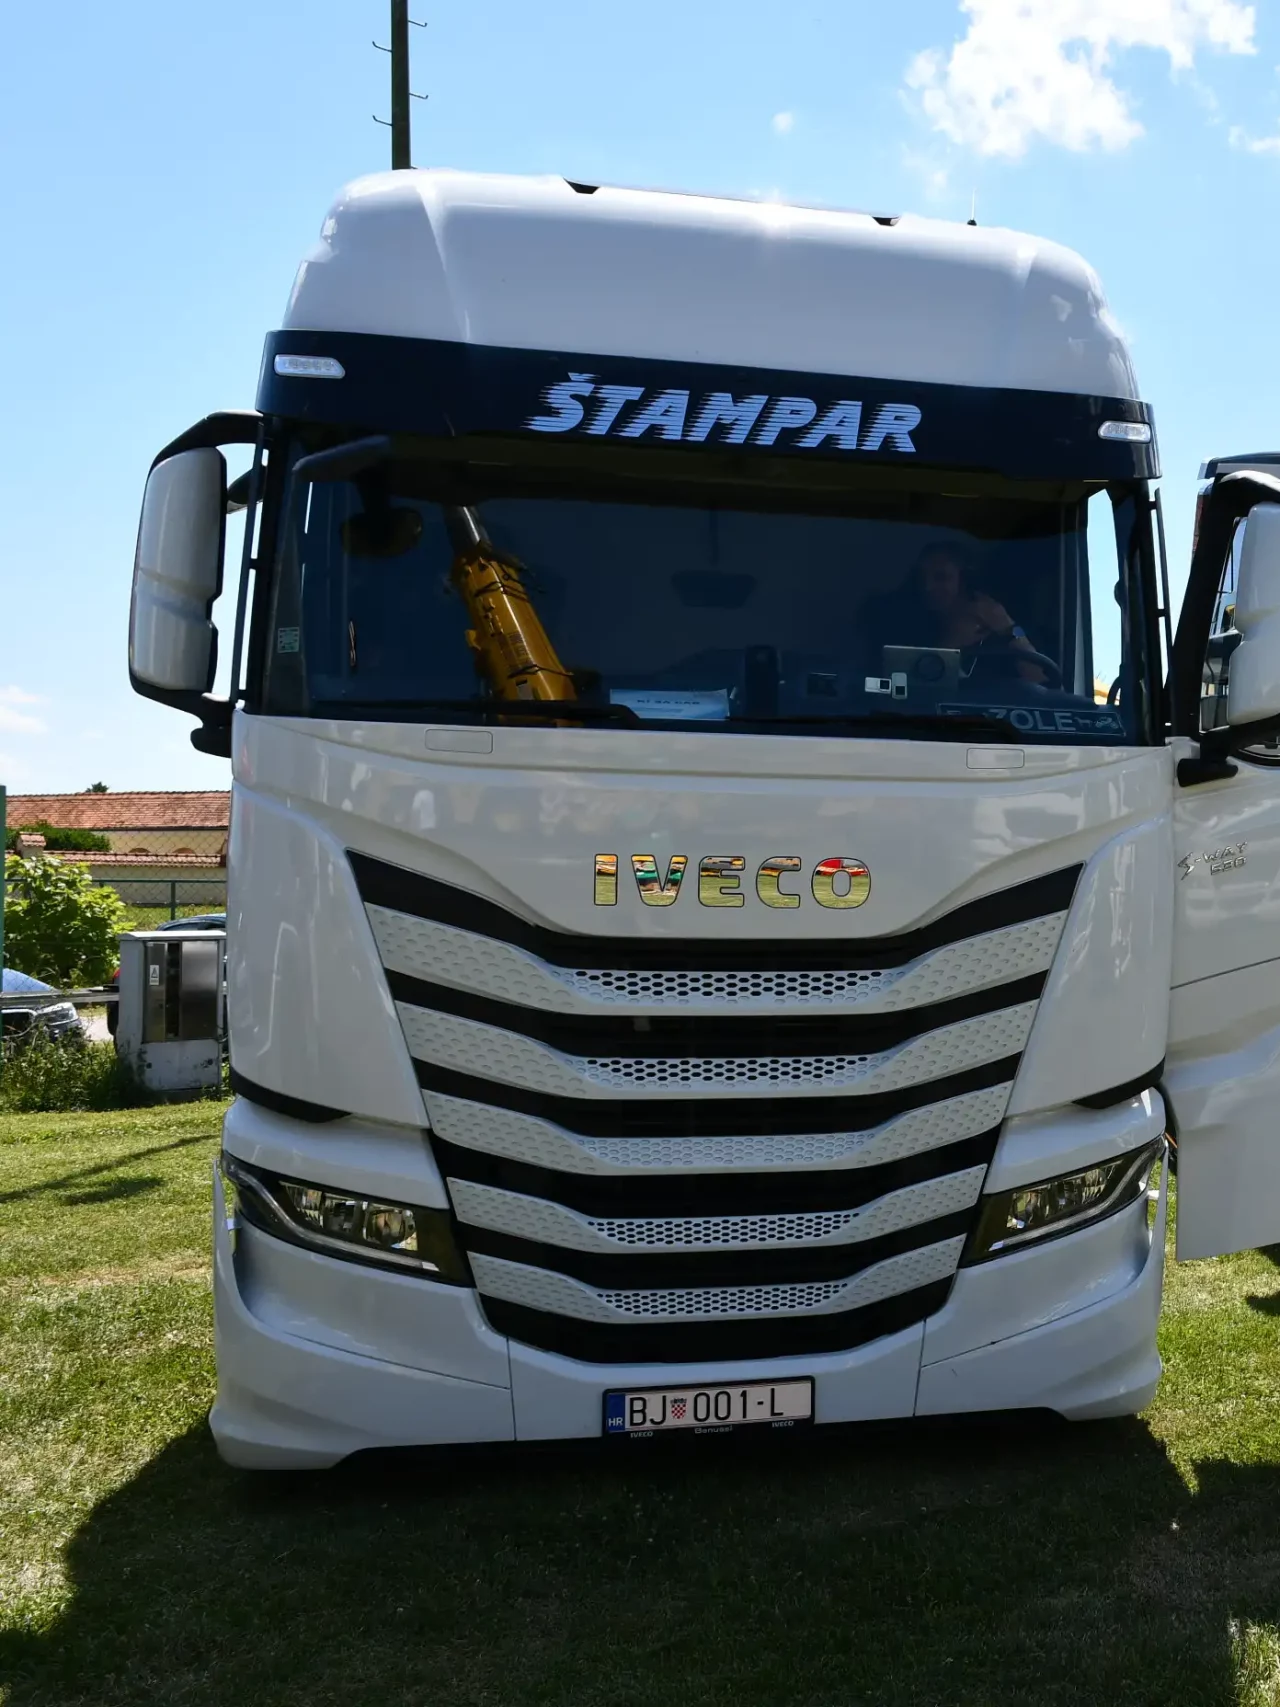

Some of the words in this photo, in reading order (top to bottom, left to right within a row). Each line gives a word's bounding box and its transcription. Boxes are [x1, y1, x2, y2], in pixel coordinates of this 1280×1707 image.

[520, 371, 922, 453] ŠTAMPAR
[594, 853, 872, 909] IVECO
[629, 1395, 667, 1427] BJ
[693, 1387, 784, 1422] 001-L
[608, 1417, 624, 1427] HR
[630, 1430, 654, 1438] IVECO
[771, 1420, 794, 1428] IVECO
